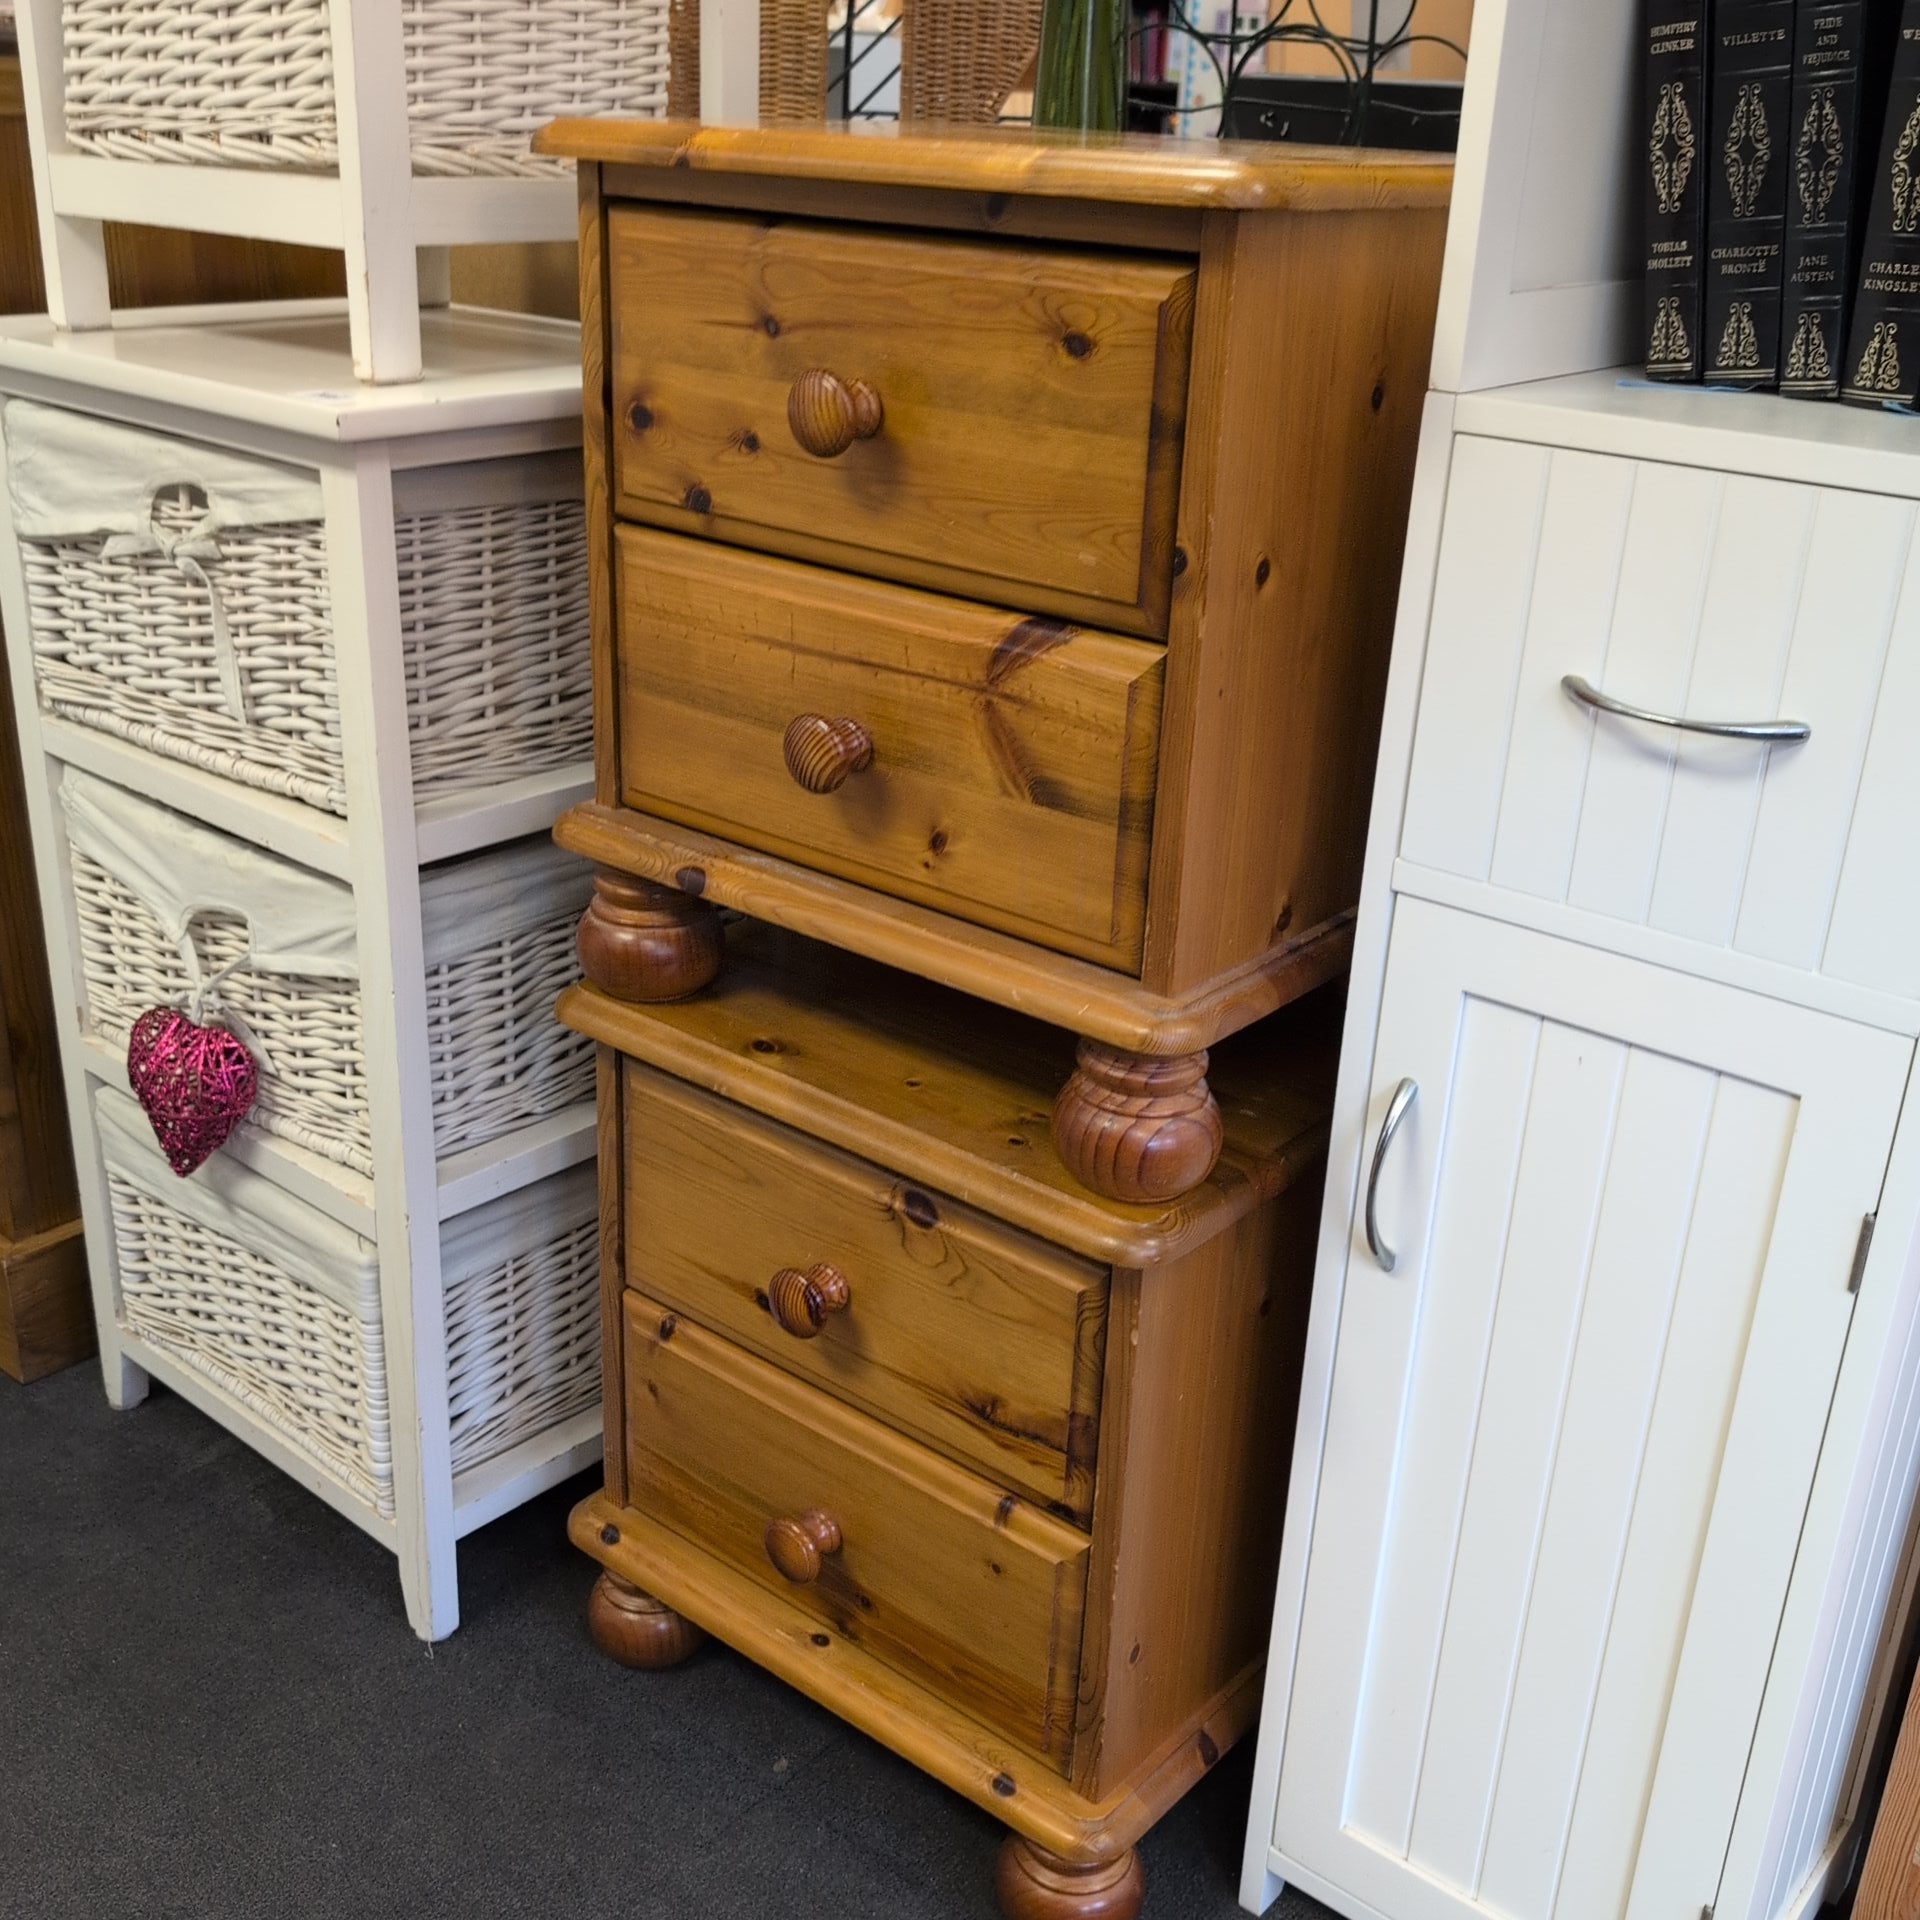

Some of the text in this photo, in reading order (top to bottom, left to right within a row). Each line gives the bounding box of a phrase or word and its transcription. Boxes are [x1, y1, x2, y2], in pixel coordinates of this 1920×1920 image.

[1813, 16, 1844, 29] PRIDE
[1722, 28, 1786, 47] VILLETTE
[1816, 34, 1839, 47] AND
[1650, 38, 1695, 55] CLINKER
[1651, 240, 1688, 254] TOBIAS
[1711, 244, 1780, 260] CHARLOTTE
[1647, 255, 1694, 271] SMOLLETT
[1797, 255, 1829, 270] JANE
[1869, 262, 1920, 276] CHARLE
[1790, 270, 1835, 284] AUSTEN
[1863, 278, 1920, 293] KINGSLE
